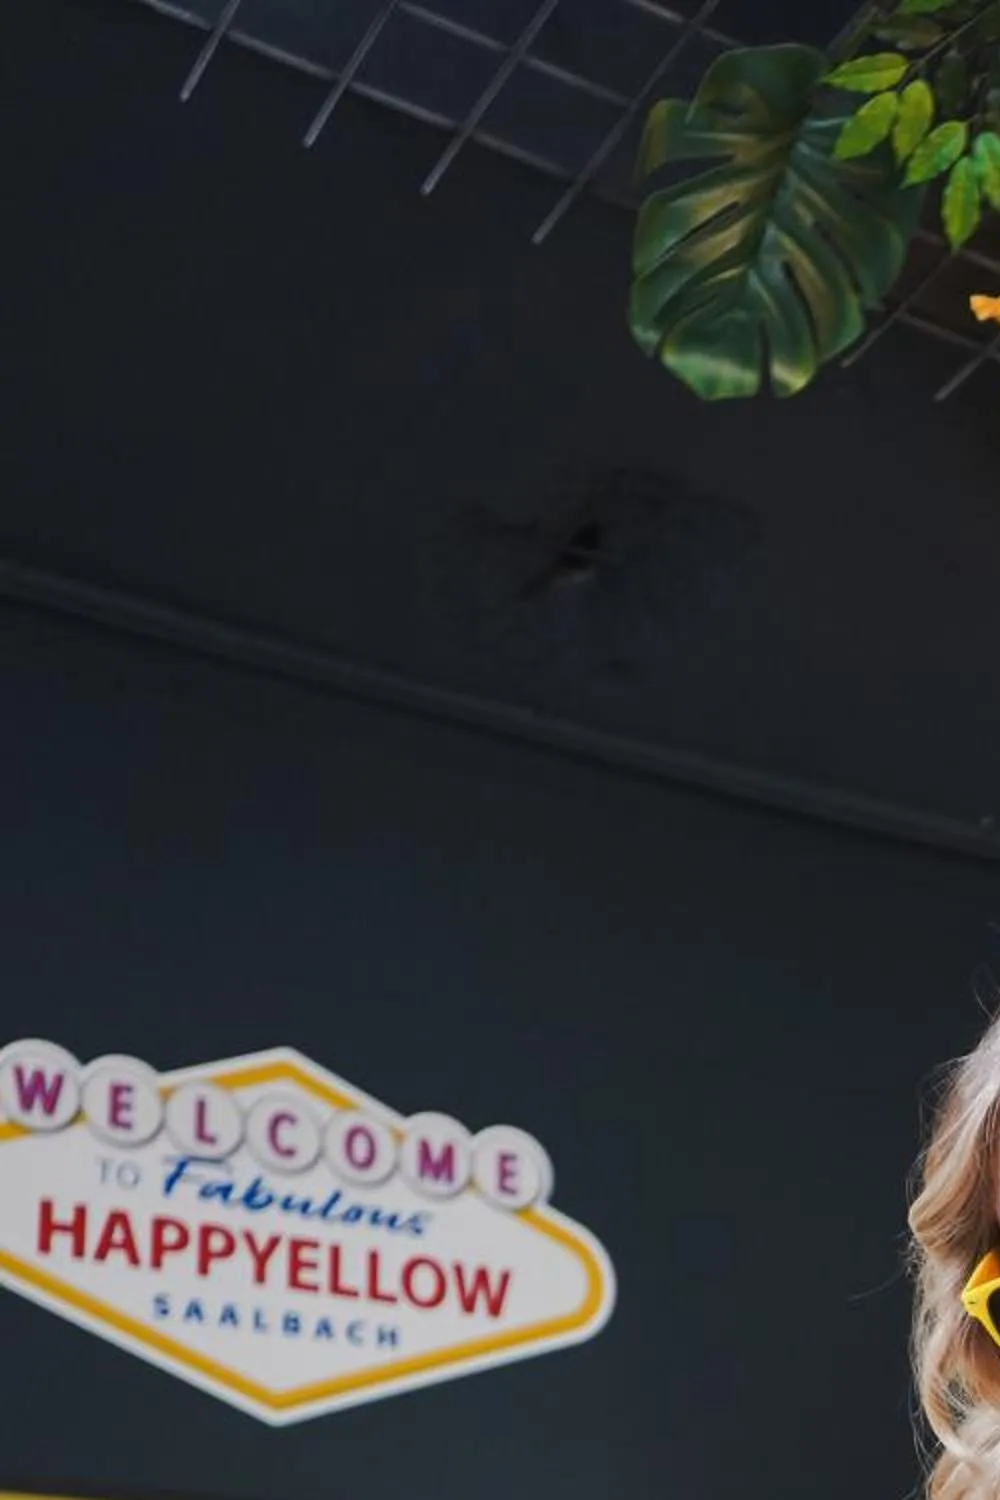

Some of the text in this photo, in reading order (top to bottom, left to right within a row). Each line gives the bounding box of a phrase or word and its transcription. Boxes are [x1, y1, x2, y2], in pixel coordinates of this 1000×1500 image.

[13, 1064, 518, 1195] WELCOME
[99, 1157, 432, 1236] TO Fabulous
[38, 1198, 511, 1318] HAPPYELLOW
[152, 1294, 400, 1347] SAALBACH
